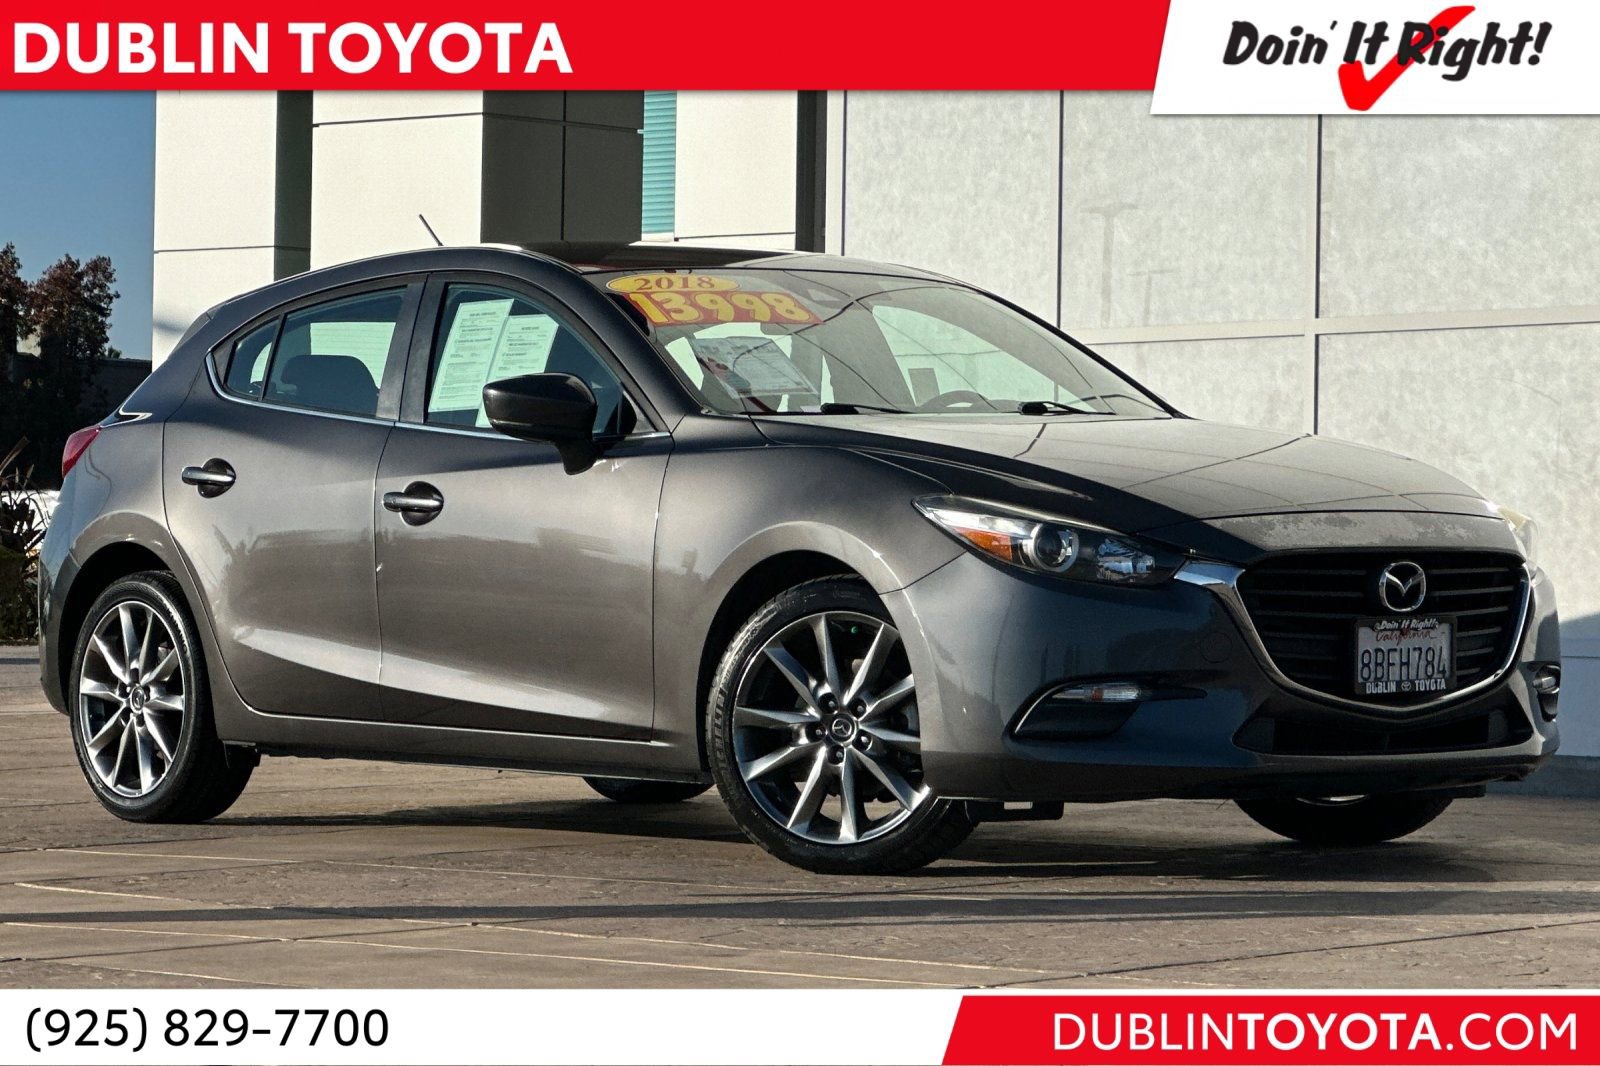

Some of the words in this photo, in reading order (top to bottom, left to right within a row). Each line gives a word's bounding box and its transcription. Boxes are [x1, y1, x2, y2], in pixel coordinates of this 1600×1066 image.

[634, 275, 716, 291] 2018
[629, 291, 811, 324] 13998
[1360, 647, 1446, 681] 8BFH784
[1366, 682, 1396, 694] DUBLIN
[1415, 679, 1446, 691] TOYOTA
